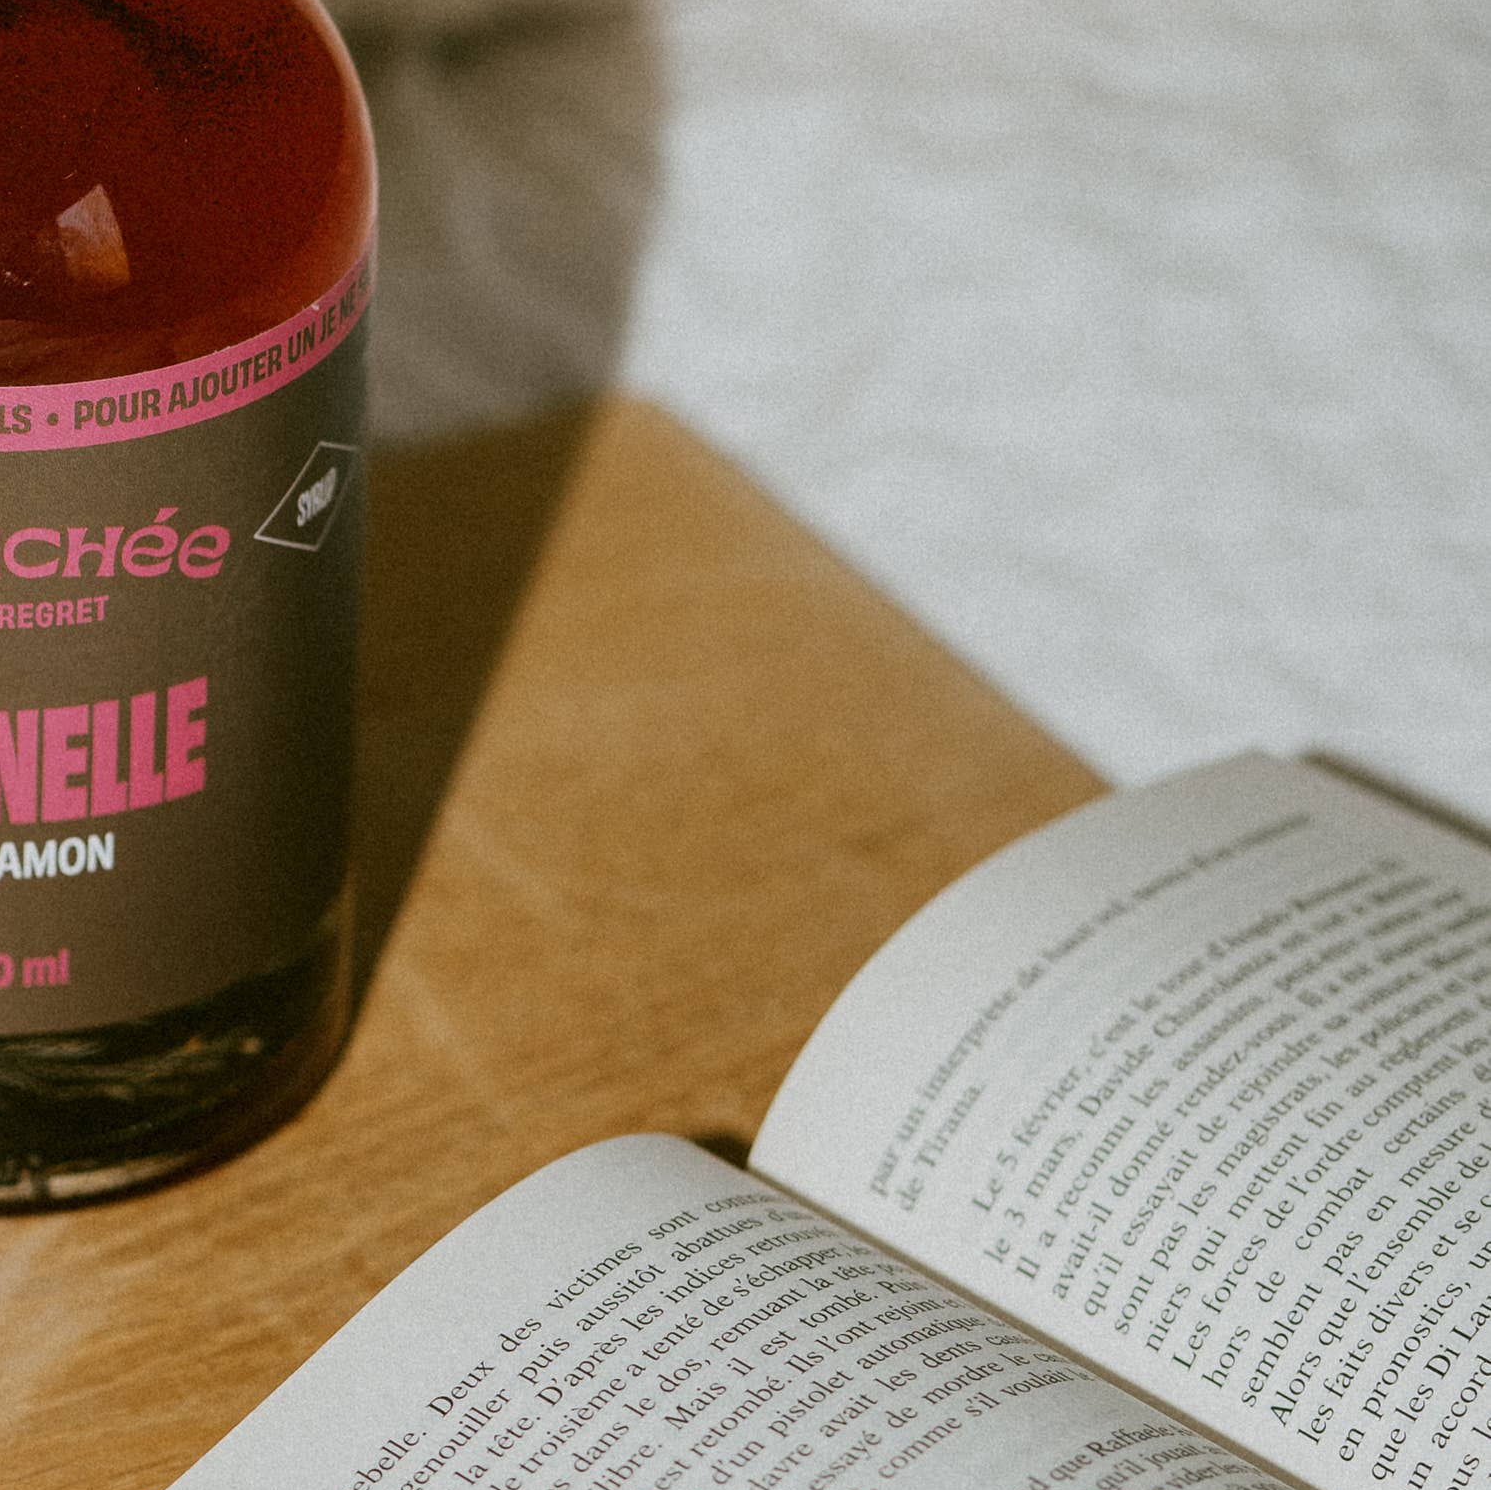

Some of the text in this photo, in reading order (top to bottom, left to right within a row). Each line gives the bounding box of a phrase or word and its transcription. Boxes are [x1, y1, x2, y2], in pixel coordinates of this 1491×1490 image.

[74, 388, 161, 429] POUR
[167, 344, 282, 413] AJOUTER
[288, 321, 315, 364] UN
[319, 303, 336, 344] JE
[22, 948, 71, 988] ml
[971, 1175, 1003, 1213] Le
[983, 1042, 1154, 1264] le 3 mars, Davide
[1014, 1078, 1170, 1280] Il a reconnu les
[1052, 1118, 1174, 1300] avait-il donné
[1121, 1147, 1198, 1248] essayait
[1198, 1114, 1229, 1144] de
[1145, 1073, 1377, 1354] niers qui mettent fin au
[1201, 1089, 1467, 1390] hors de combat certains
[426, 1360, 495, 1418] Deux
[498, 1317, 542, 1353] des
[547, 1241, 642, 1311] victimes
[648, 1209, 699, 1241] sont
[518, 1336, 570, 1385] puis
[576, 1264, 666, 1333] aussitôt
[671, 1216, 762, 1261] abattues
[1114, 1274, 1155, 1335] sont
[1149, 1220, 1188, 1271] pas
[1178, 1181, 1217, 1218] les
[1171, 1318, 1212, 1372] Les
[1200, 1232, 1267, 1315] forces
[1265, 1198, 1295, 1230] de
[1240, 1121, 1477, 1407] semblent pas en mesure
[1269, 1153, 1490, 1428] Alors que de
[1297, 1210, 1482, 1446] les faits divers et se
[459, 1462, 488, 1486] la
[487, 1415, 541, 1458] tête.
[622, 1303, 664, 1332] les
[659, 1254, 745, 1304] indices
[520, 1377, 626, 1474] troisième
[626, 1362, 645, 1378] a
[642, 1314, 703, 1361] tenté
[703, 1294, 733, 1317] de
[573, 1420, 629, 1473] dans
[623, 1397, 655, 1420] le
[659, 1358, 711, 1394] dos,
[710, 1287, 807, 1352] remuant
[805, 1276, 830, 1291] la
[832, 1265, 874, 1282] tête
[655, 1461, 691, 1490] est
[690, 1376, 792, 1457] retombé.
[783, 1349, 824, 1375] Ils
[878, 1298, 942, 1327] rejoint
[664, 1380, 726, 1430] Mais
[726, 1357, 754, 1379] il
[761, 1327, 797, 1355] est
[799, 1288, 878, 1329] tombé.
[768, 1369, 854, 1437] pistolet
[857, 1314, 986, 1371] automatique
[819, 1391, 877, 1438] avait
[875, 1369, 917, 1391] les
[921, 1339, 982, 1369] dents
[878, 1414, 962, 1480] comme
[1000, 1369, 1072, 1399] voulait
[886, 1406, 918, 1429] de
[921, 1359, 1004, 1407] mordre
[1005, 1353, 1030, 1367] le
[1337, 1281, 1471, 1462] en pronostics,
[1371, 1347, 1462, 1481] que les Di
[1049, 1452, 1093, 1485] que
[1085, 1425, 1172, 1458] Raffaele
